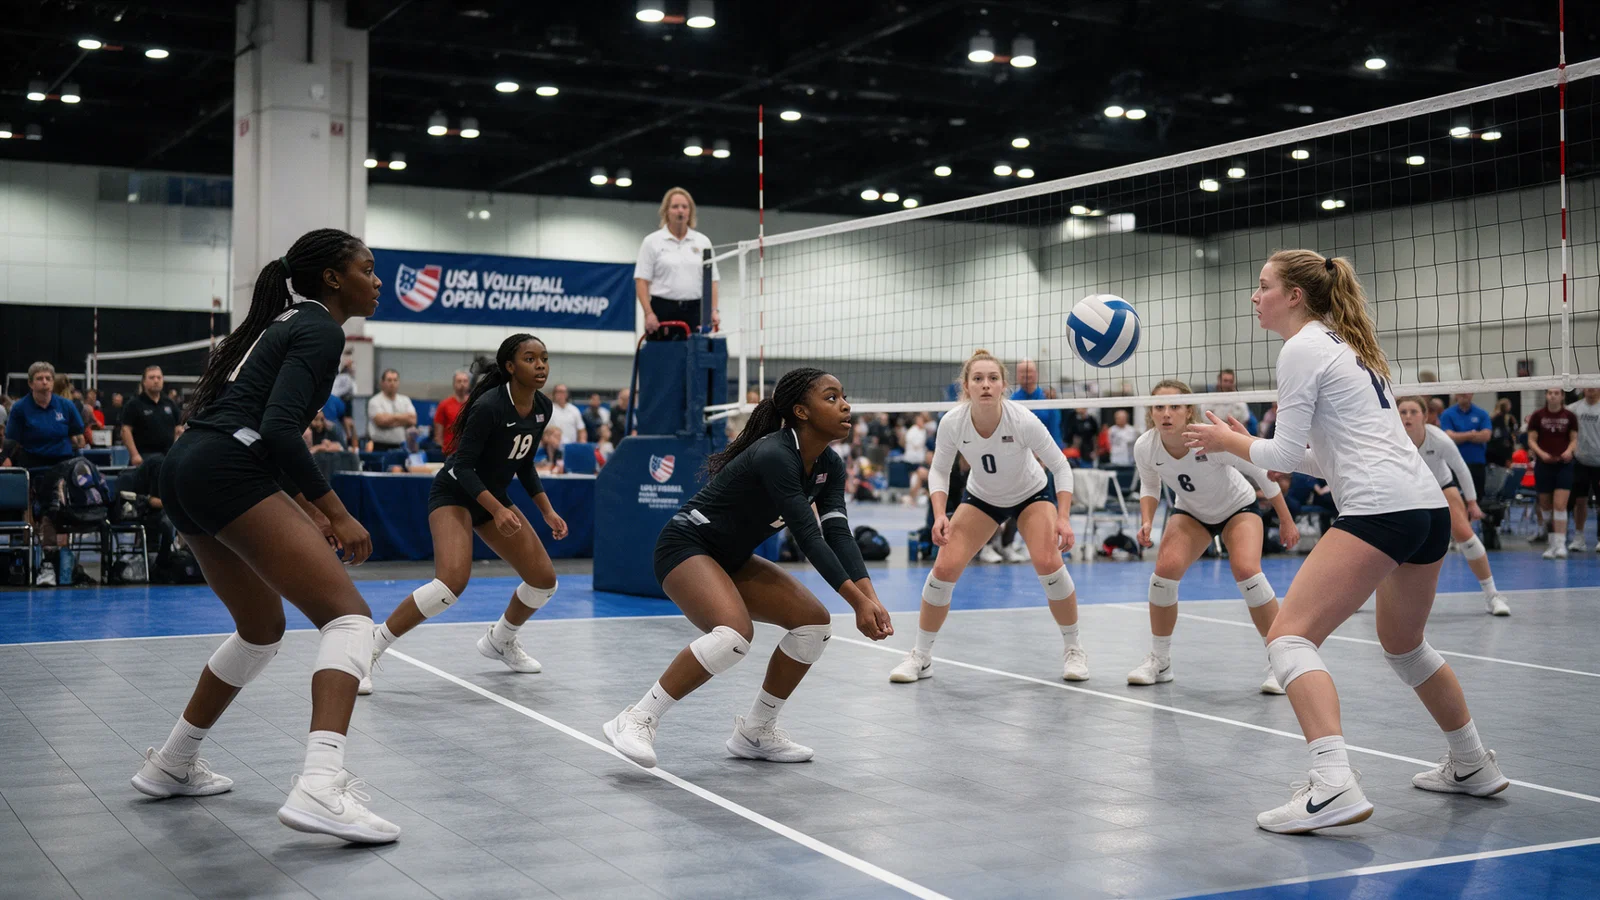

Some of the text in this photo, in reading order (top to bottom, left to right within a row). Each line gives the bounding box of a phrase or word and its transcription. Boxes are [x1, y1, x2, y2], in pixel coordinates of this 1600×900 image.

[445, 269, 564, 293] USA VOLLEYBALL
[441, 289, 609, 317] OPEN CHAMPIONSHIP
[508, 434, 533, 460] 19
[981, 453, 997, 474] 0
